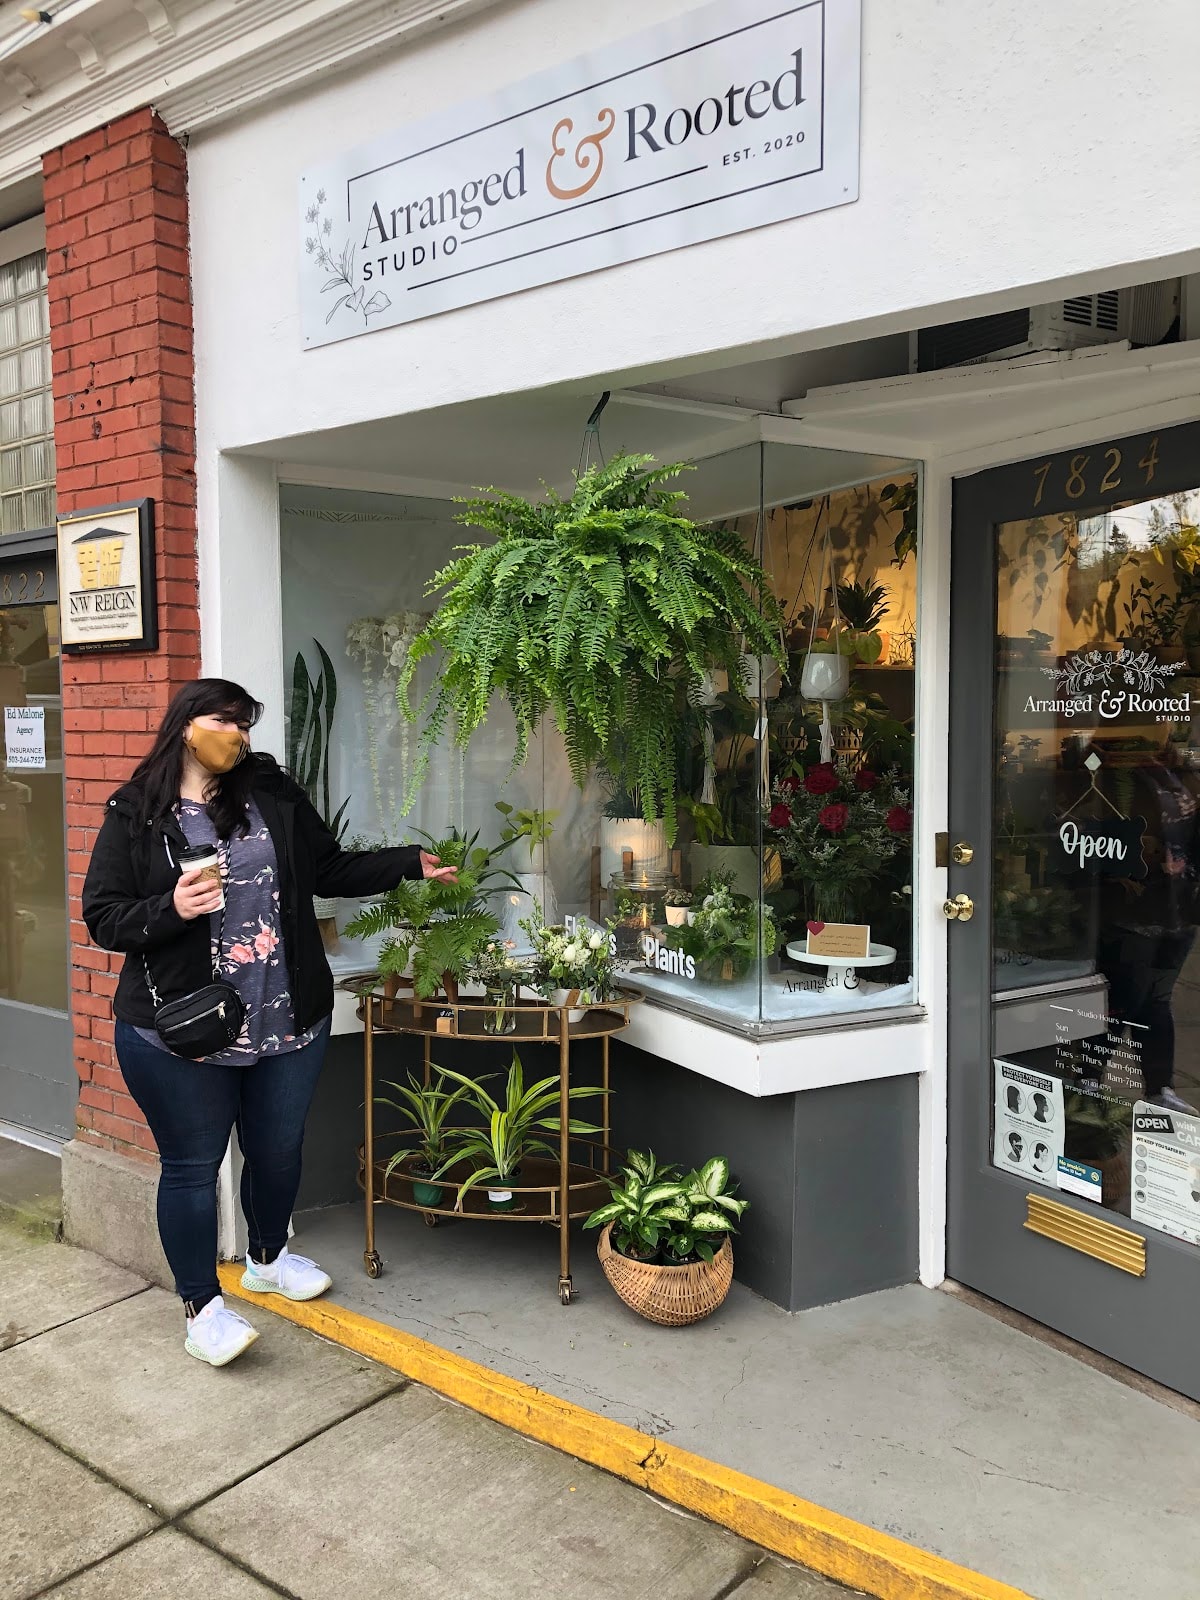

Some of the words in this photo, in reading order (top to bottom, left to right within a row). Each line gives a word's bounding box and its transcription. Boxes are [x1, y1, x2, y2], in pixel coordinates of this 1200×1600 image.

[361, 148, 528, 250] Arranged
[545, 107, 616, 200] &
[623, 47, 806, 163] Rooted
[721, 149, 758, 167] EST.
[763, 131, 806, 155] 2020
[362, 235, 459, 281] STUDIO
[1033, 437, 1160, 508] 7824
[69, 595, 91, 615] NW
[95, 590, 137, 612] REIGN
[7, 708, 16, 719] Ed
[18, 708, 44, 719] Malone
[1023, 694, 1093, 718] Arranged
[1098, 690, 1126, 719] &
[1128, 693, 1191, 712] Rooted
[16, 726, 34, 735] Agency
[1059, 821, 1128, 869] Open
[645, 934, 696, 980] Plants
[782, 972, 839, 994] Arranged
[843, 967, 860, 990] &
[1077, 1008, 1098, 1020] Studio
[1099, 1013, 1120, 1025] Hours
[1055, 1022, 1069, 1032] Sun
[1107, 1033, 1143, 1049] 11am-4pm
[1055, 1034, 1071, 1046] Mon
[1082, 1040, 1092, 1051] by
[1093, 1043, 1142, 1062] appointment
[1056, 1047, 1074, 1059] Tues
[1081, 1053, 1103, 1066] Thurs
[1003, 1067, 1025, 1078] PROTECT
[1025, 1073, 1052, 1086] YOURSELF
[1014, 1075, 1040, 1088] EVERYONE
[1055, 1059, 1065, 1069] Fri
[1071, 1064, 1084, 1075] Sat
[1107, 1072, 1143, 1088] 11am-7pm
[1135, 1117, 1170, 1130] OPEN
[1175, 1120, 1197, 1133] with
